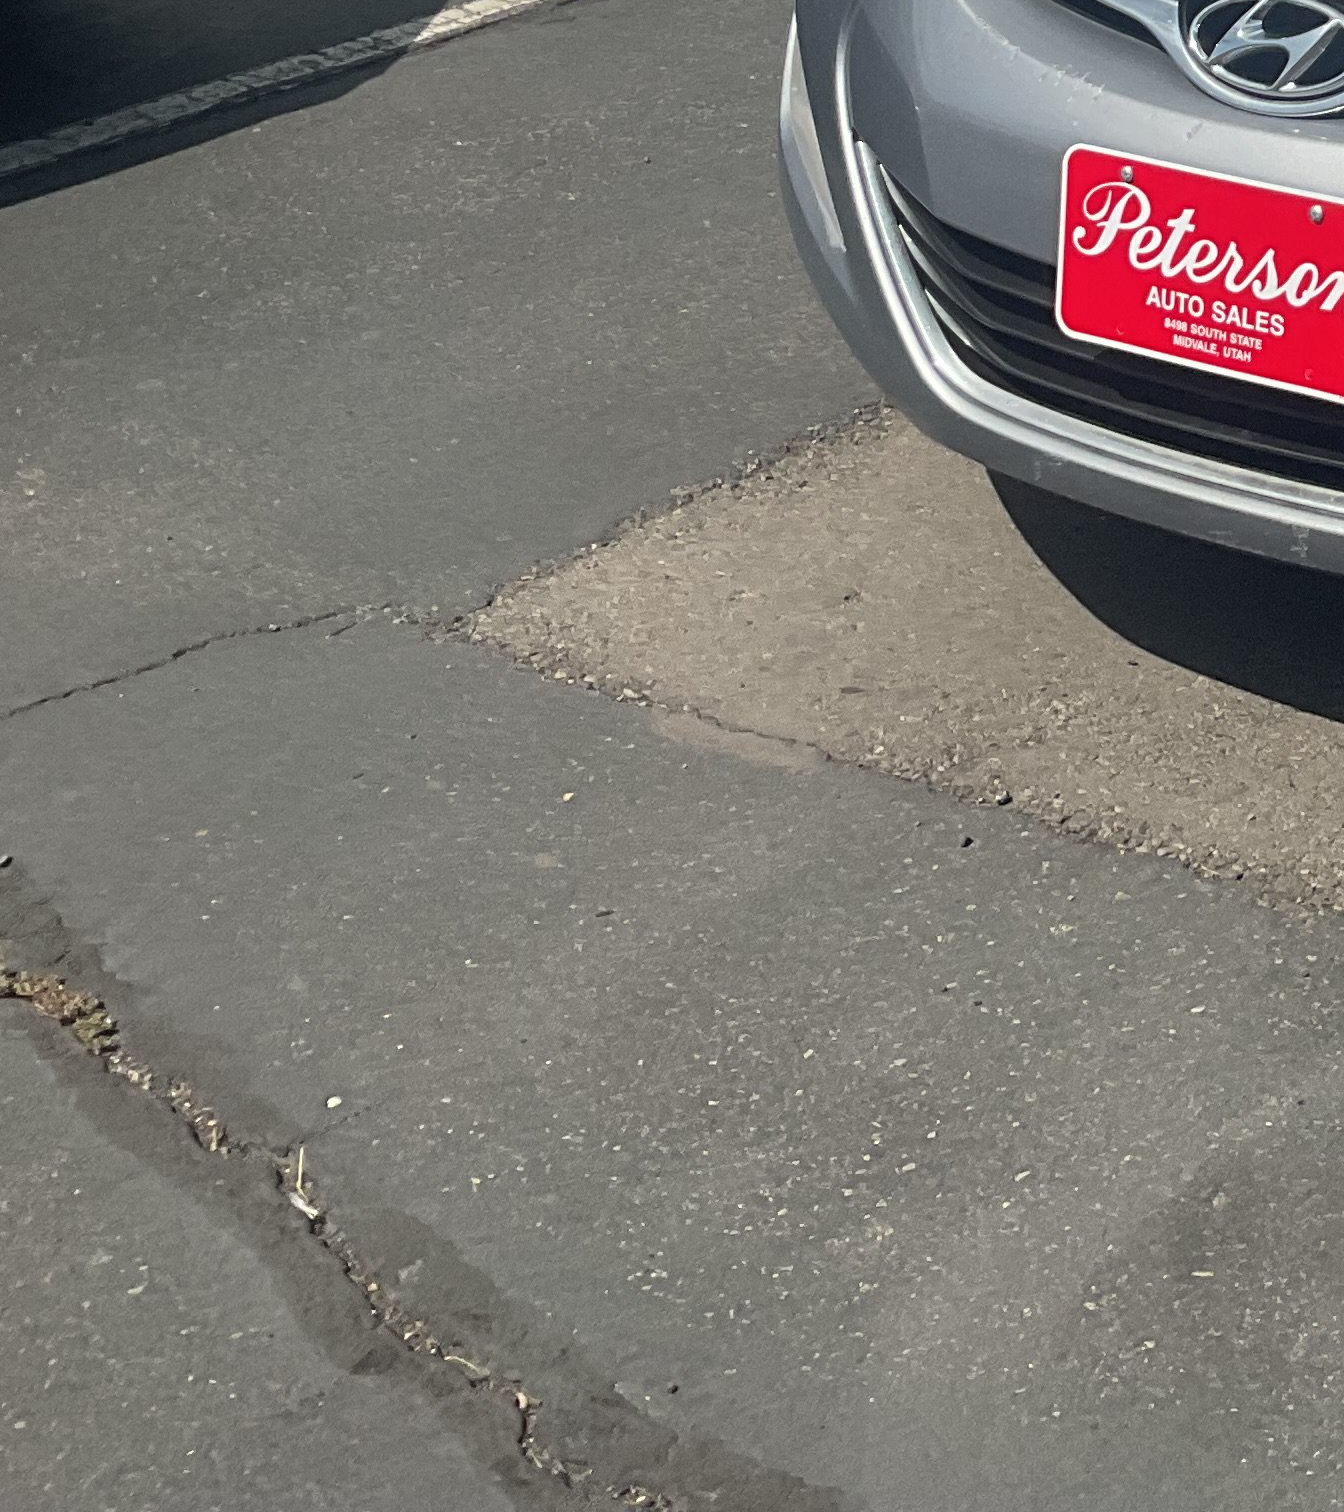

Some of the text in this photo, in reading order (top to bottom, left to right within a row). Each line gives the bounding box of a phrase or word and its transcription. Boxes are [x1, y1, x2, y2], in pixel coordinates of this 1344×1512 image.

[1145, 286, 1285, 336] AUTO SALES
[1164, 317, 1263, 350] 8498 SOUTH STATE
[1172, 334, 1252, 363] MIDVALE, UTAH
